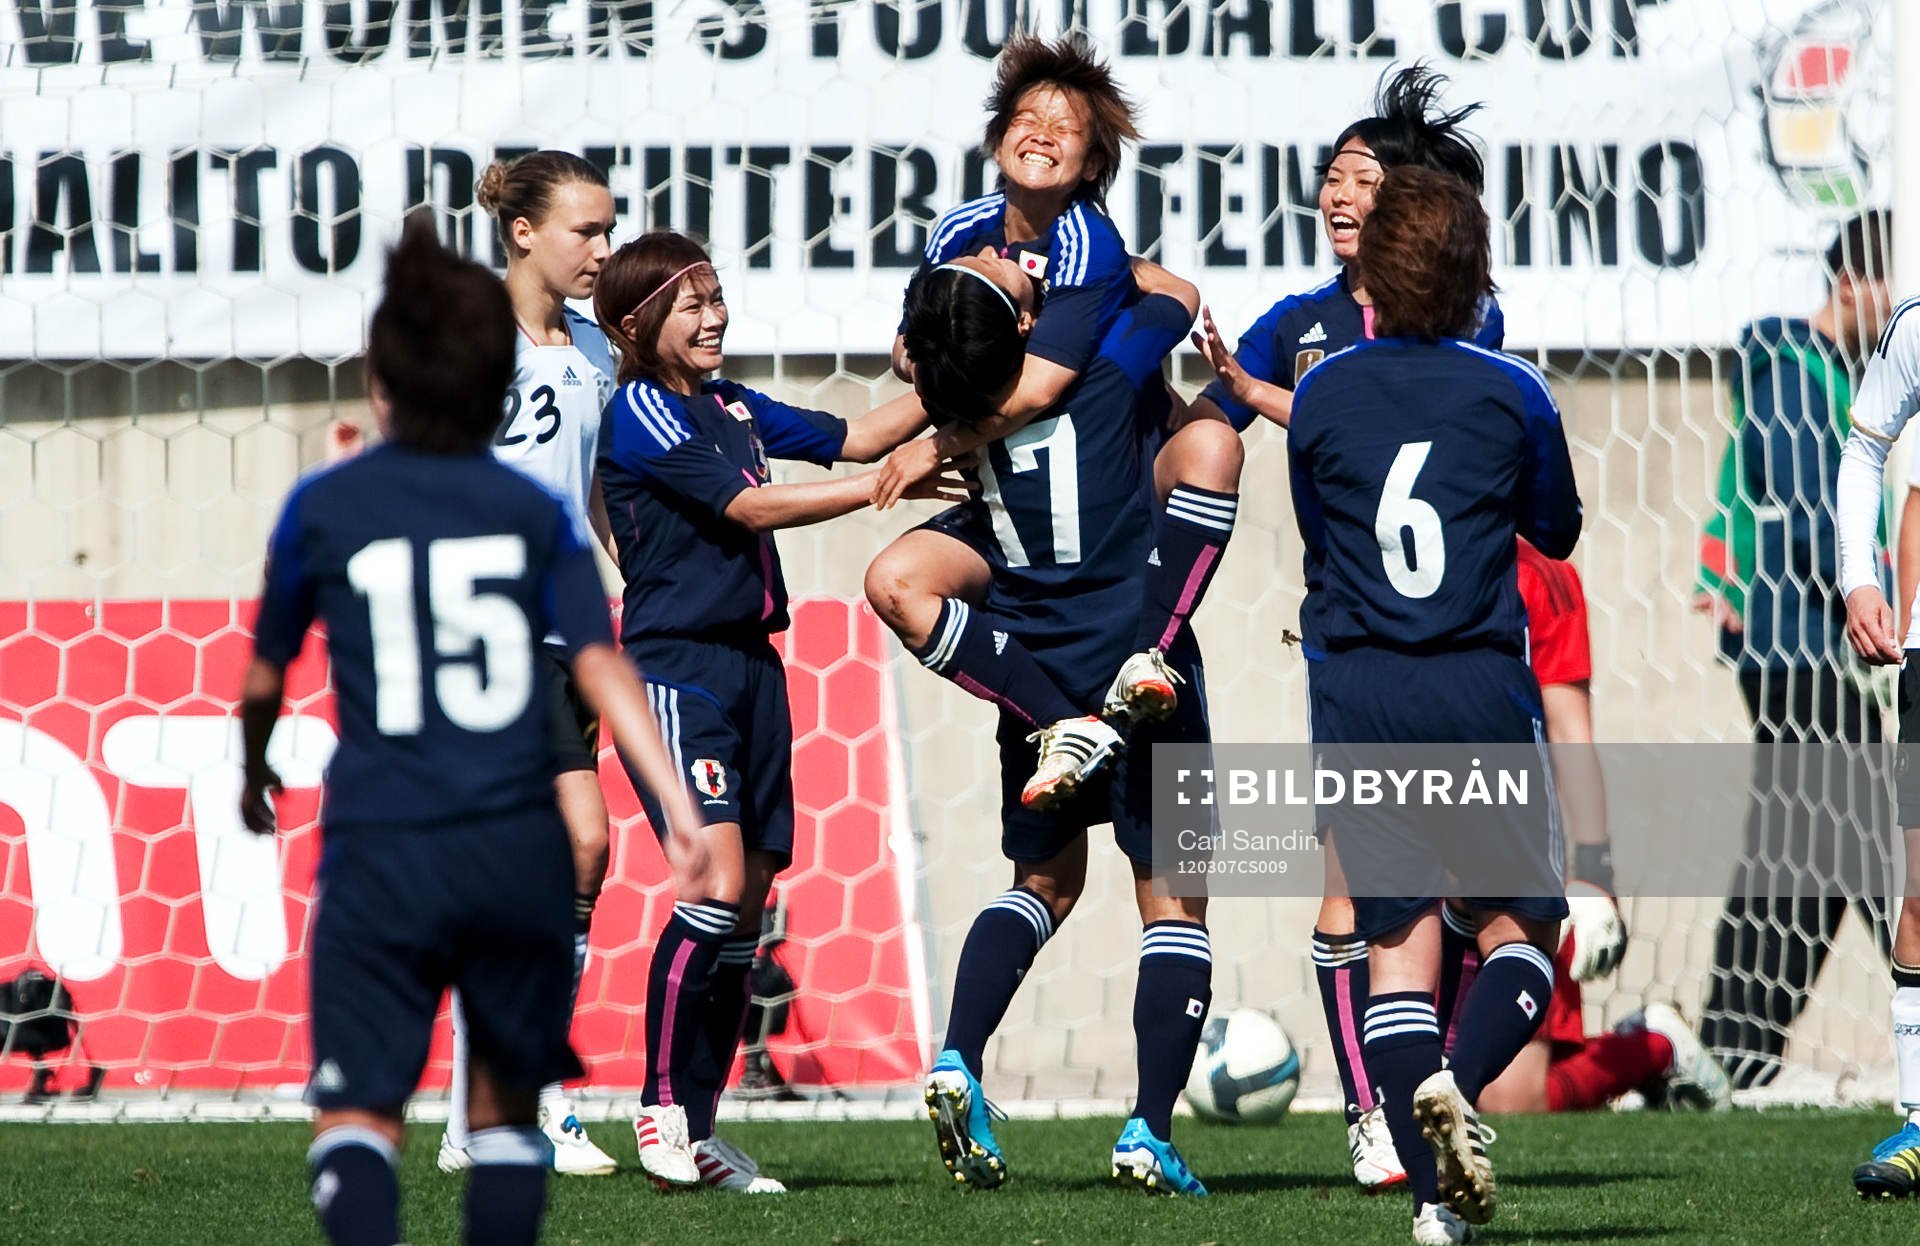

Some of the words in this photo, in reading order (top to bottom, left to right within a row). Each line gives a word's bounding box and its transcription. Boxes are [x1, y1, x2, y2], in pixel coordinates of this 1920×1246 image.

[581, 145, 990, 268] UTEB
[1137, 142, 1706, 267] FEMINO
[497, 385, 562, 446] 23
[976, 413, 1081, 567] 17
[1375, 441, 1445, 599] 6
[346, 533, 534, 736] 15
